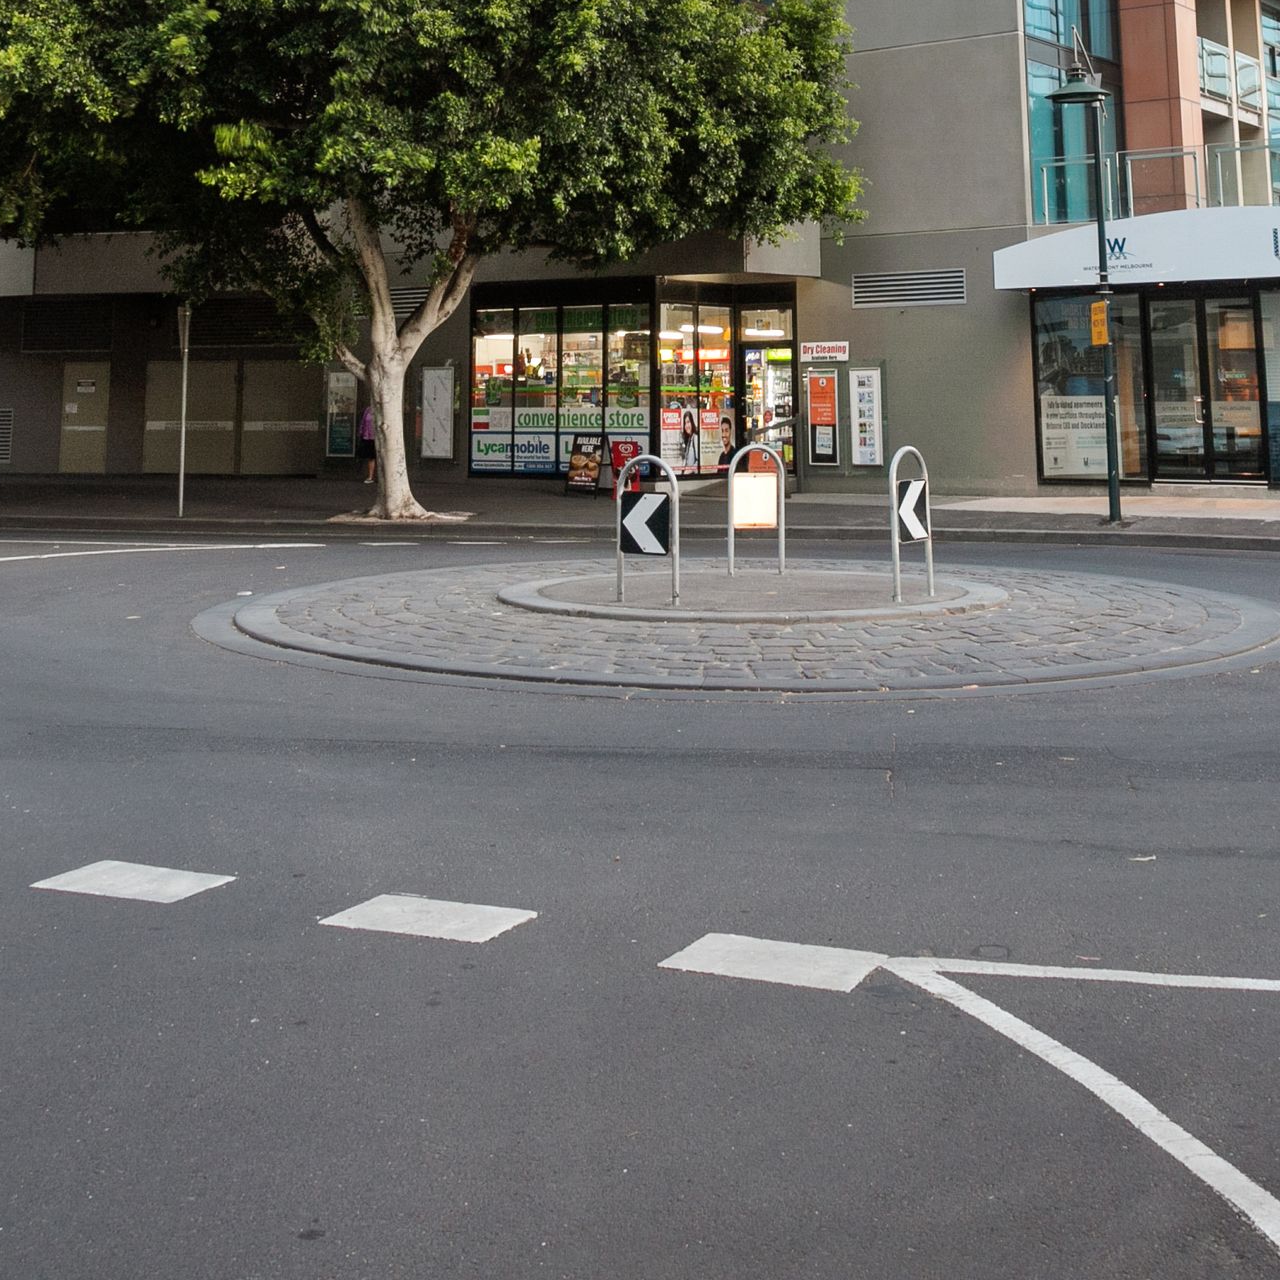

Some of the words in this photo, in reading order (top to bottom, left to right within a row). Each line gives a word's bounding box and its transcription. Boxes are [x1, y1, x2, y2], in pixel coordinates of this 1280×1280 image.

[802, 345, 814, 355] Dry
[815, 344, 847, 355] Cleaning
[1073, 401, 1103, 409] apartments
[517, 409, 602, 426] convenience
[609, 410, 644, 426] store
[1080, 422, 1106, 430] Dockland
[577, 437, 602, 445] AVAILABLE
[477, 439, 550, 456] Lycamobile
[581, 445, 594, 453] HERE
